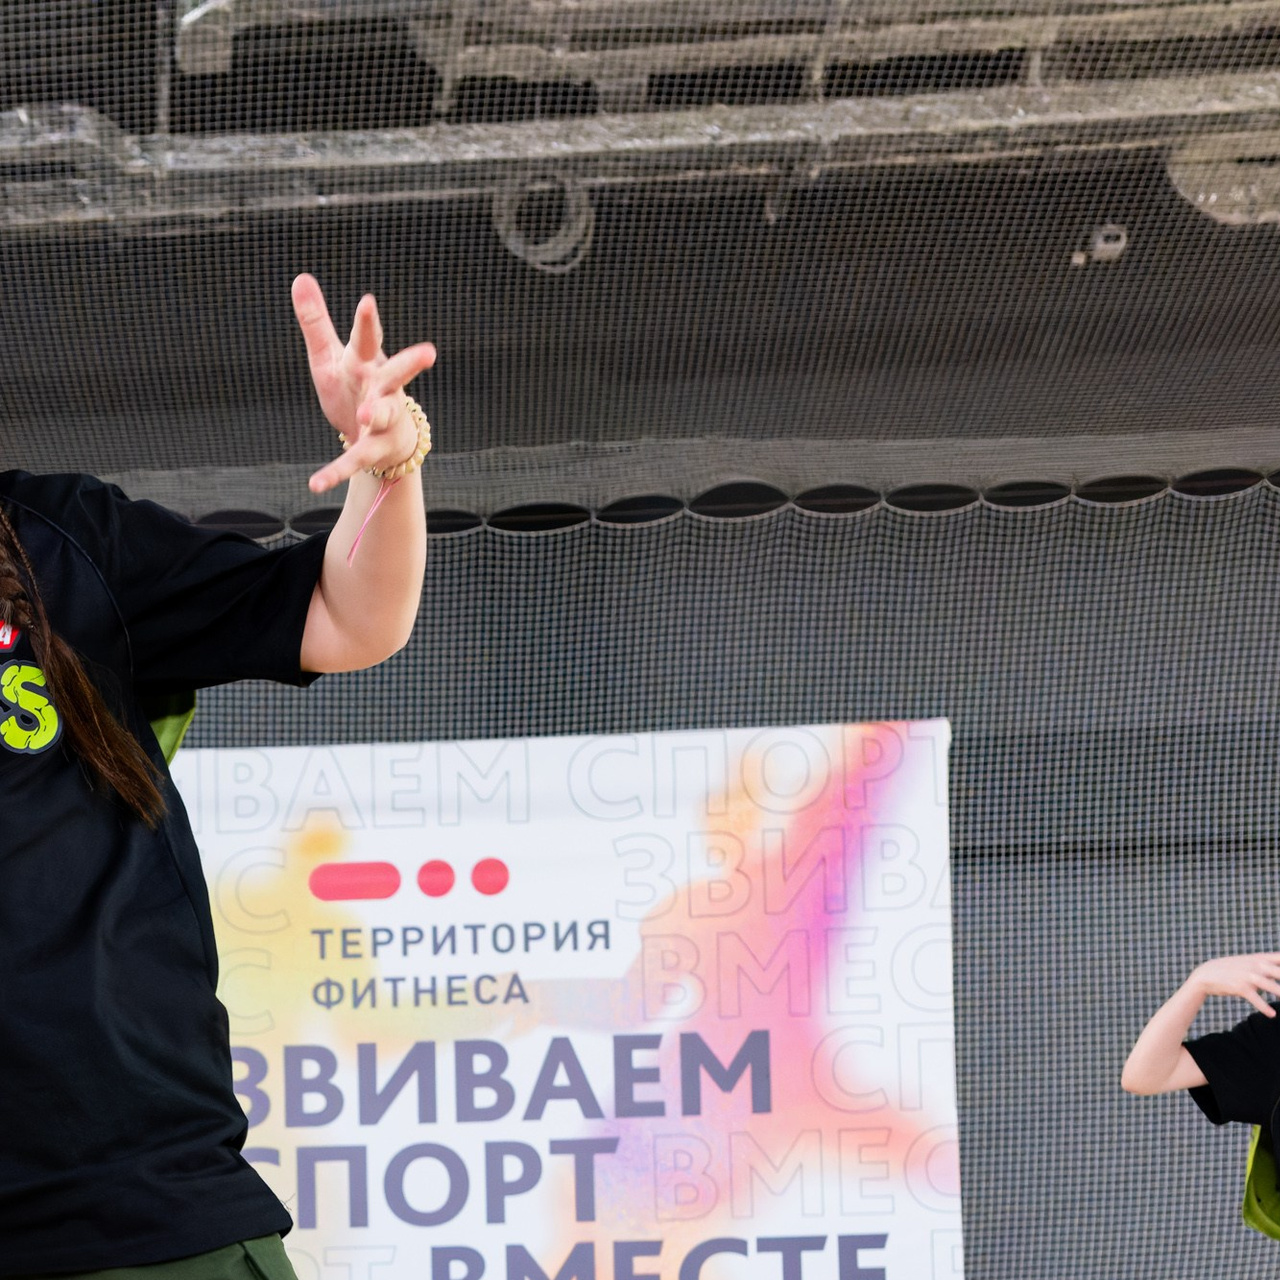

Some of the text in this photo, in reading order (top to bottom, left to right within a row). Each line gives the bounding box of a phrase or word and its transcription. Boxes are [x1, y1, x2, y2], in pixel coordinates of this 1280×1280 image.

[613, 823, 951, 922] ЗВИВ
[311, 920, 611, 959] ТЕРРИТОРИЯ
[313, 973, 530, 1010] ФИТНЕСА
